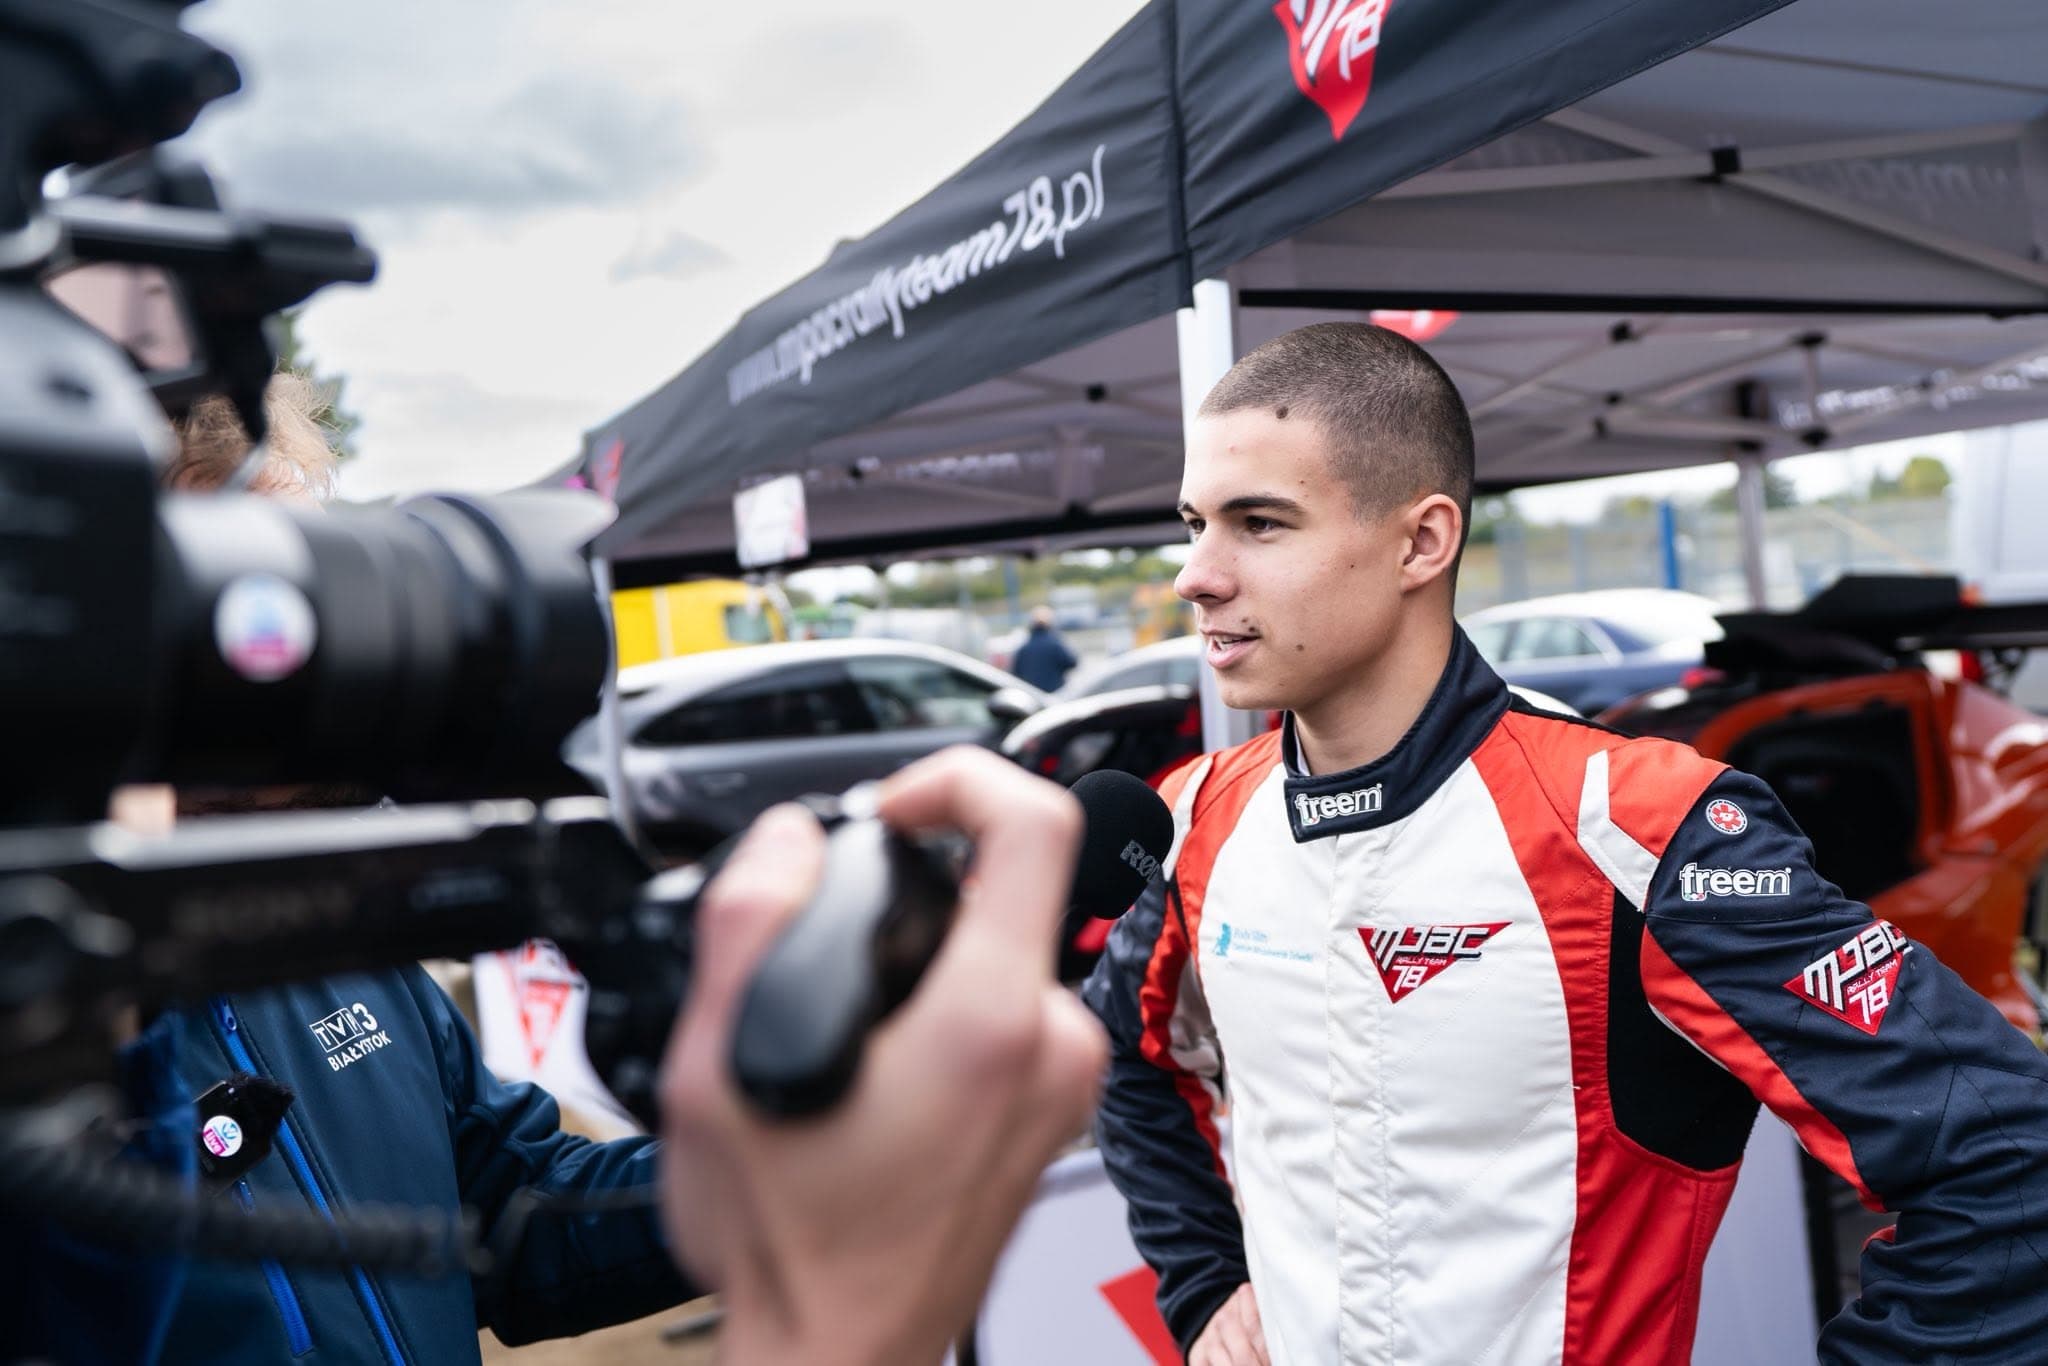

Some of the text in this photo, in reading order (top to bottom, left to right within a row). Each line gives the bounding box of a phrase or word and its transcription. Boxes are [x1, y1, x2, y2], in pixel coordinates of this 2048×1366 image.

[1295, 783, 1382, 827] freem
[1680, 862, 1791, 902] freem
[1392, 965, 1428, 994] 78
[1848, 977, 1889, 1025] 78
[327, 1030, 392, 1072] BIAŁYSTOK
